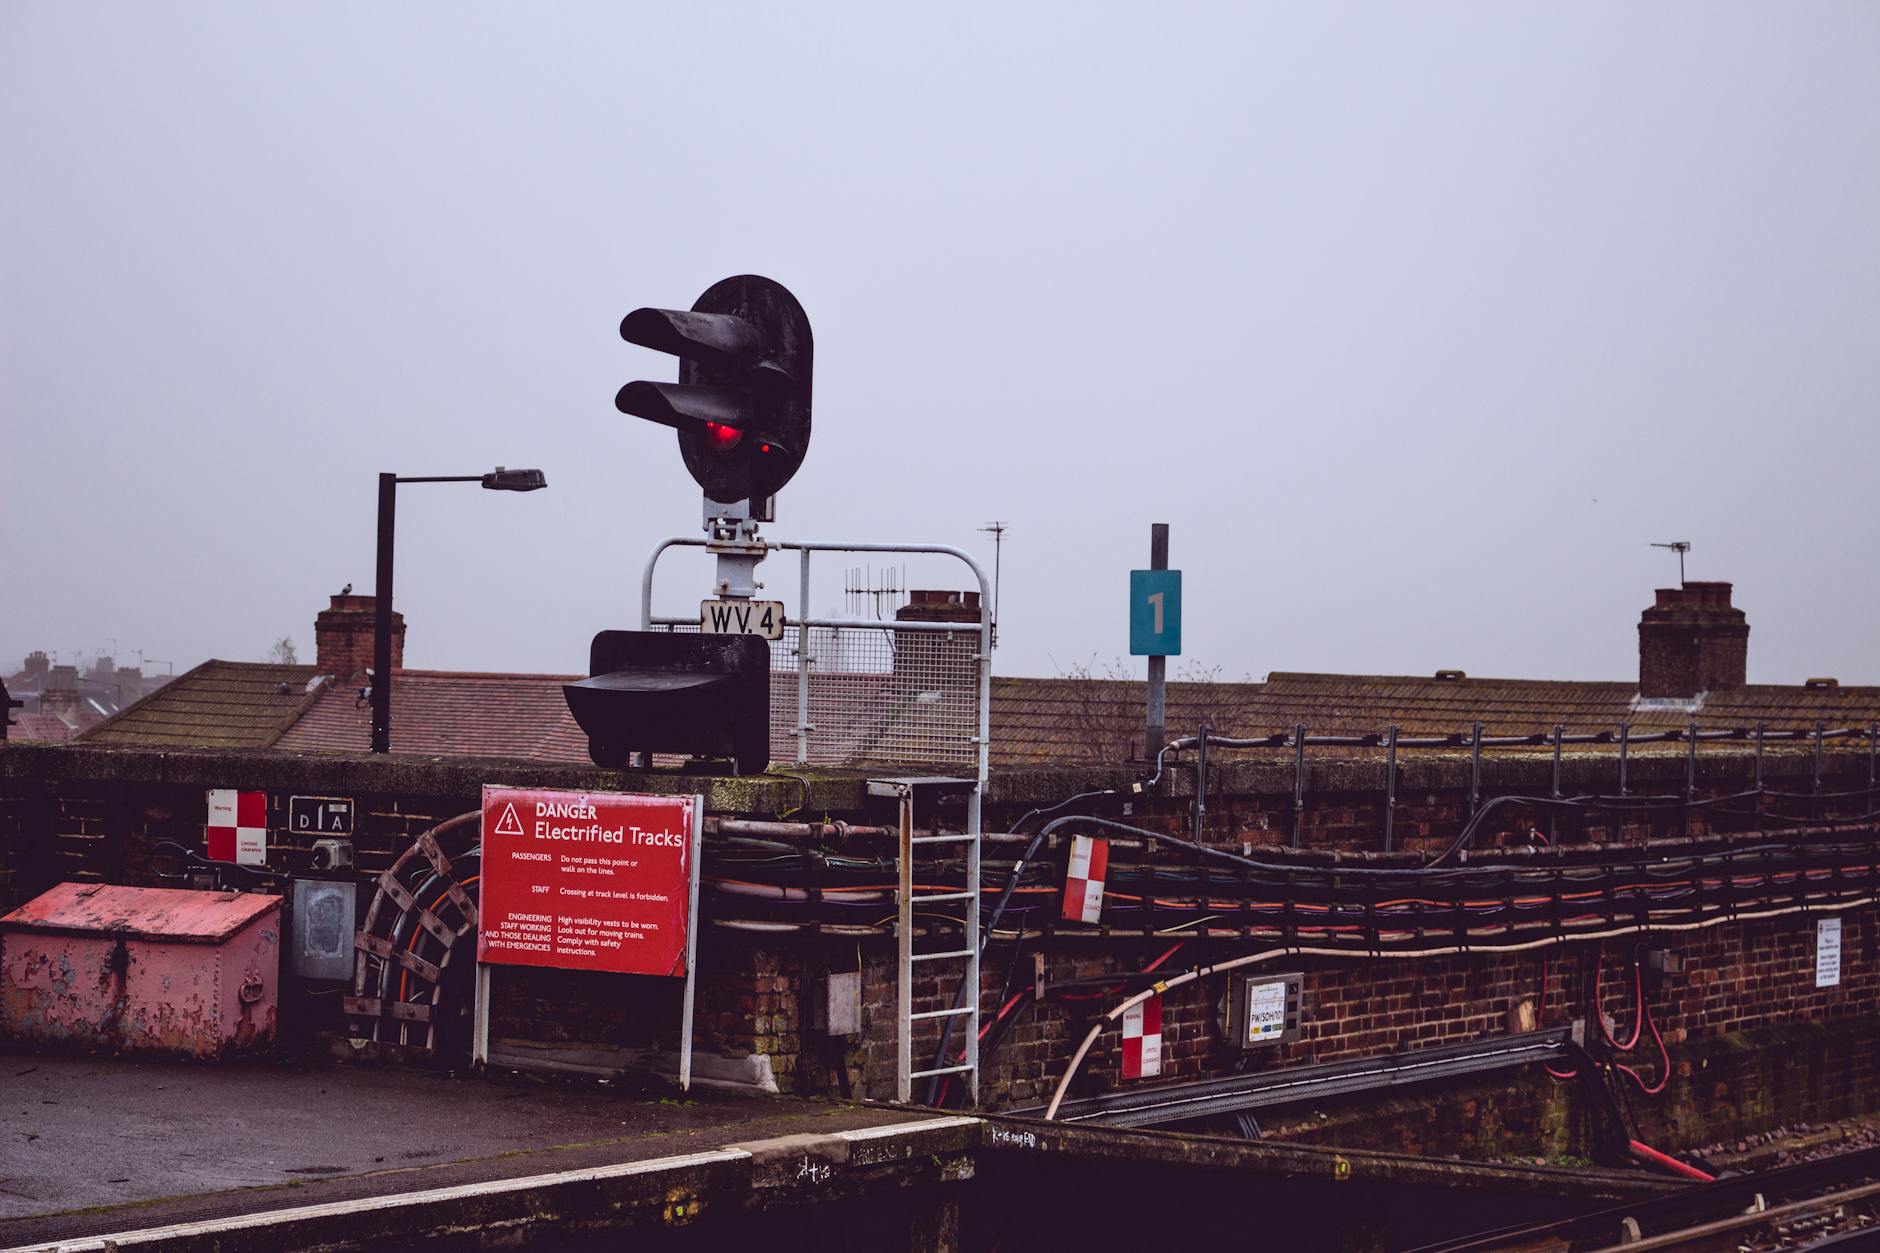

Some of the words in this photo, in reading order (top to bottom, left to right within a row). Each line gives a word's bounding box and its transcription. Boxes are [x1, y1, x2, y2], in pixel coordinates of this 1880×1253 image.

[1148, 592, 1164, 634] 1
[536, 802, 597, 820] DANGER
[535, 822, 623, 843] Electrified
[630, 827, 682, 847] Tracks
[512, 852, 551, 861] PASSENGERS
[571, 856, 582, 864] not
[584, 857, 597, 866] pass
[599, 857, 610, 866] this
[612, 859, 629, 868] point
[560, 888, 586, 898] Crossing
[596, 890, 611, 898] track
[613, 891, 628, 899] level
[637, 892, 668, 902] forbidden.
[509, 913, 552, 922] ENGINEERING
[558, 916, 573, 926] High
[574, 917, 602, 928] visibility
[603, 920, 620, 928] vests
[631, 921, 639, 929] be
[641, 922, 658, 930] worn.
[501, 922, 518, 930] STAFF
[520, 923, 551, 932] WORKING
[485, 930, 499, 938] AND
[500, 931, 521, 940] THOSE
[523, 933, 551, 942] DEALING
[588, 928, 597, 936] for
[599, 930, 623, 939] moving
[624, 931, 644, 940] trains.
[507, 941, 550, 952] EMERGENCIES
[557, 936, 583, 947] Comply
[584, 938, 599, 946] with
[600, 940, 621, 949] safety
[557, 946, 596, 957] instructions.
